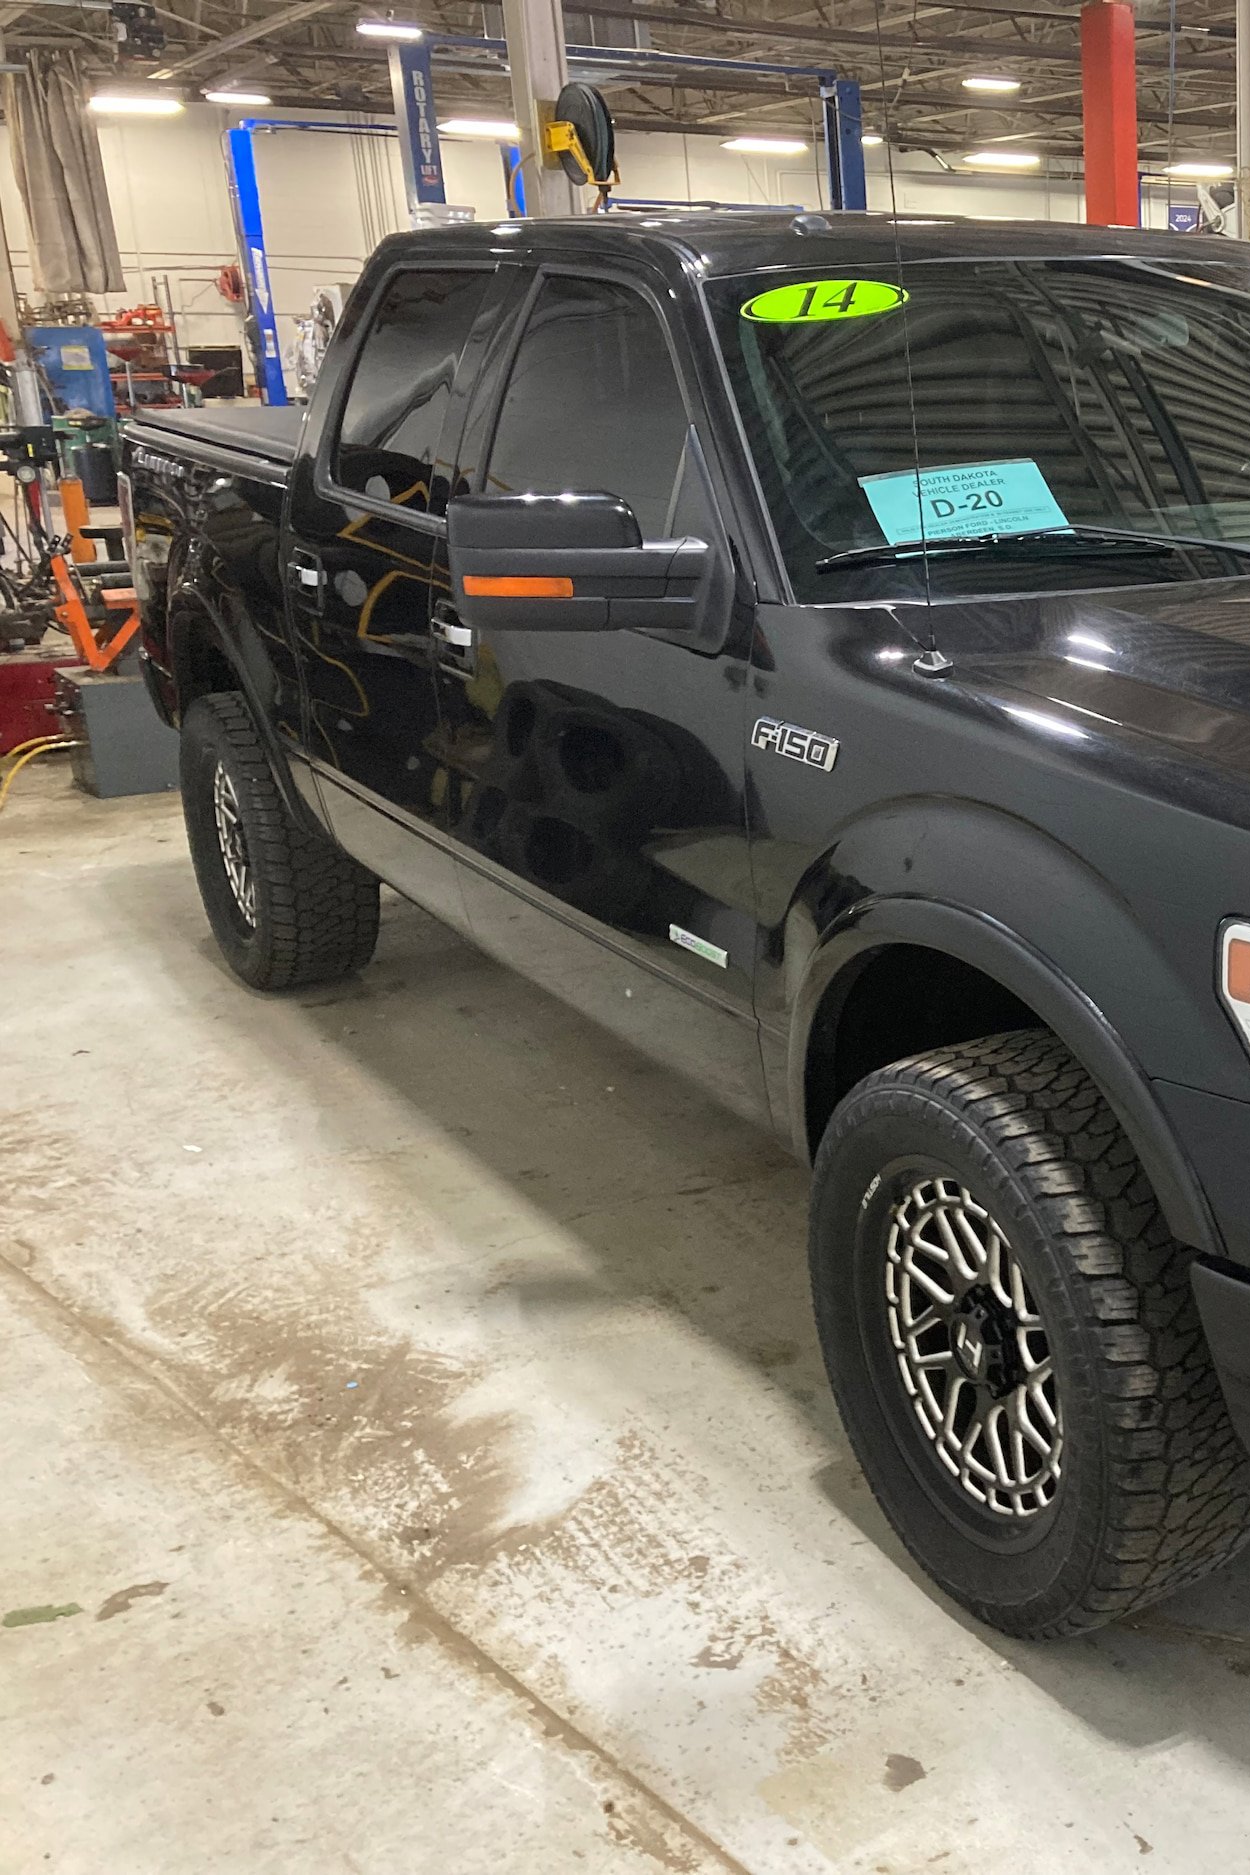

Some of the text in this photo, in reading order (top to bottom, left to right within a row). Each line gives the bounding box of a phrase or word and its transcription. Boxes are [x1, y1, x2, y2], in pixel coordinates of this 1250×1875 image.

[411, 70, 432, 164] ROTARY
[1175, 214, 1192, 222] 2024
[791, 281, 858, 319] 14
[912, 470, 998, 488] SOUTH DAKOTA
[912, 478, 1006, 498] VEHICLE DEALER
[930, 490, 1003, 519] D-20
[928, 524, 964, 537] PIERSON
[965, 520, 988, 529] FORD
[994, 515, 1029, 525] LINCOLN
